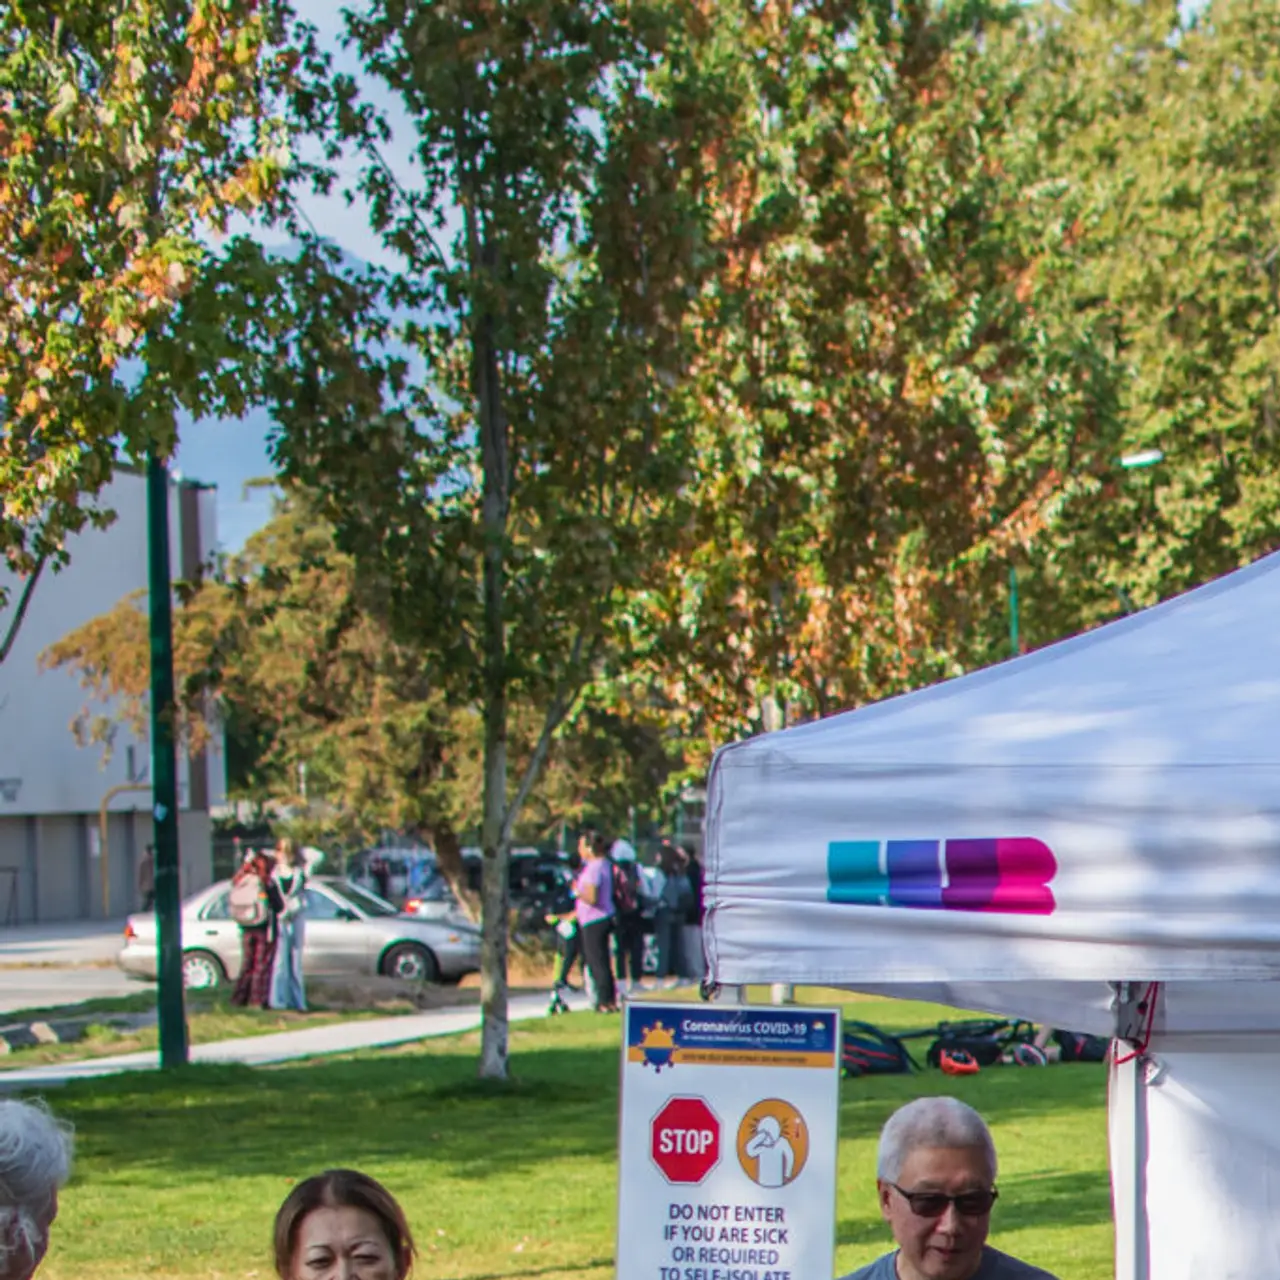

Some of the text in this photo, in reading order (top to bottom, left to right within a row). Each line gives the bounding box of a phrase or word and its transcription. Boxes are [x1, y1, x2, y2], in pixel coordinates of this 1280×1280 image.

[682, 1019, 808, 1036] Coronavirus COVID-19
[659, 1128, 714, 1154] STOP
[669, 1204, 785, 1222] DO NOT ENTER
[664, 1225, 788, 1244] IF YOU ARE SICK
[672, 1246, 779, 1265] OR REQUIRED
